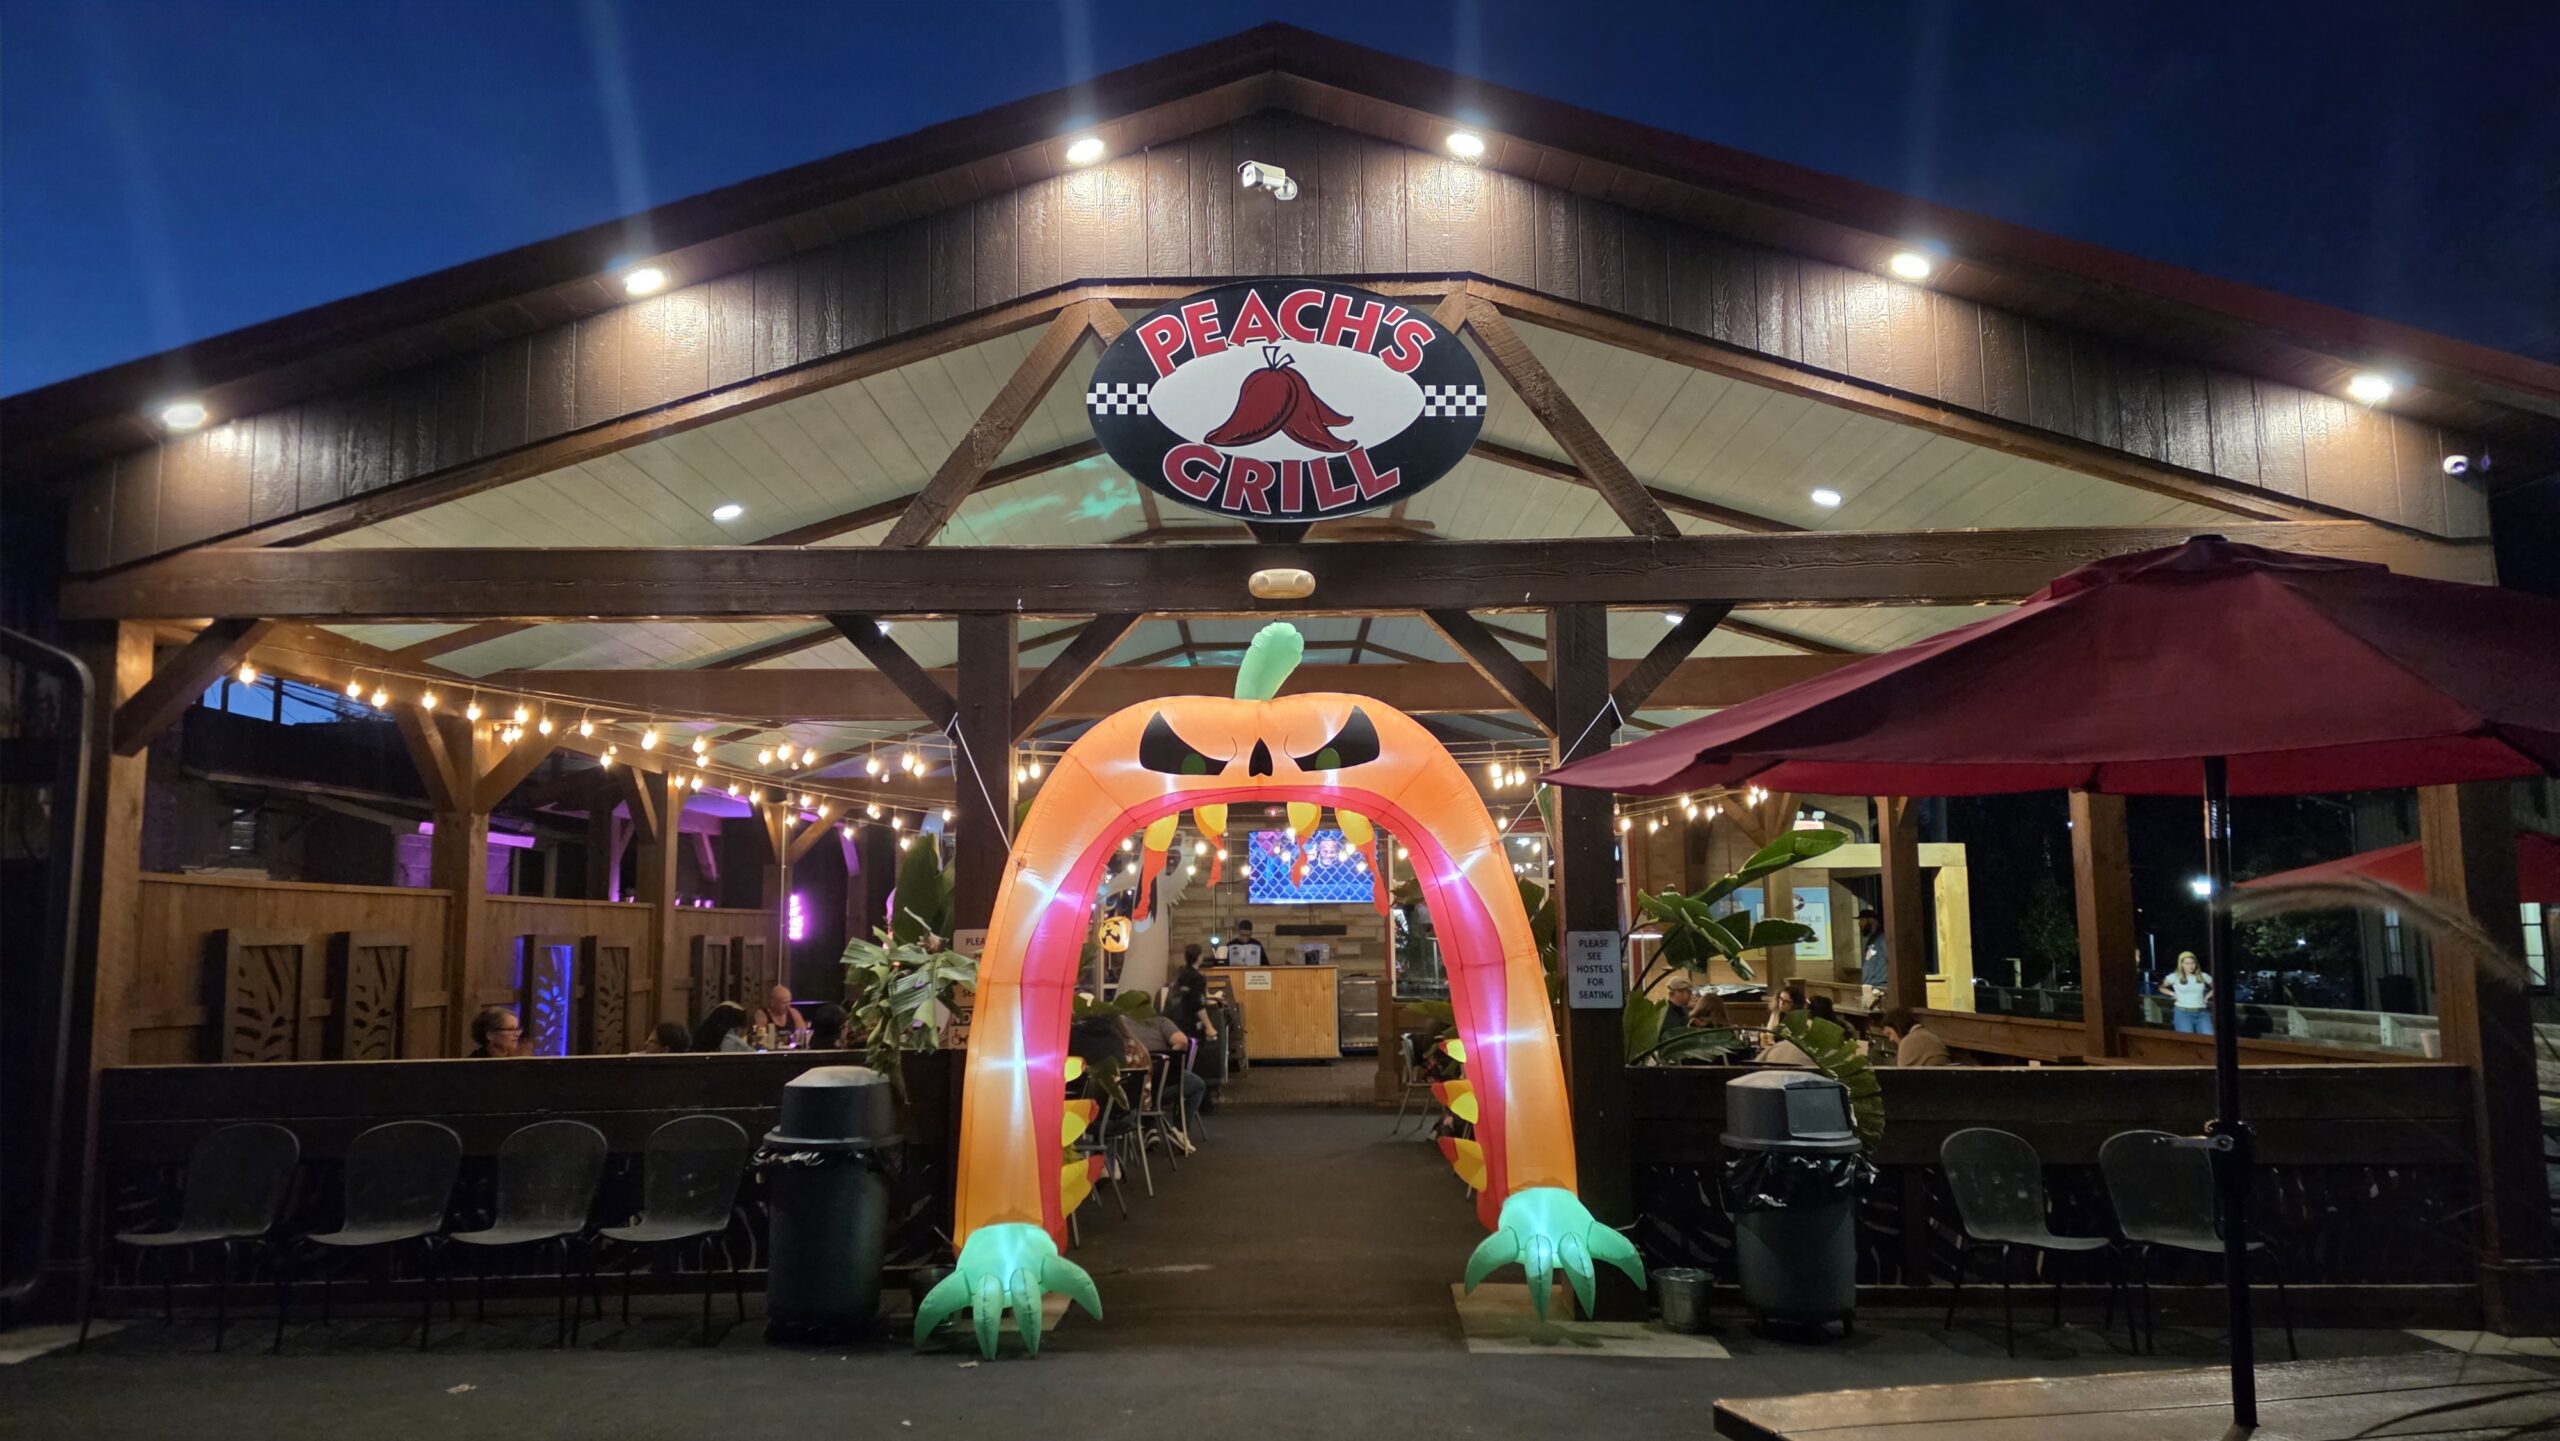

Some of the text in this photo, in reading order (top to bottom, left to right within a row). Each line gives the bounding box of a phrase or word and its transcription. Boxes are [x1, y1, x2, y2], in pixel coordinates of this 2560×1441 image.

[1136, 288, 1436, 378] PEACH'S
[1162, 443, 1400, 514] GRILL
[965, 936, 985, 946] PLEA
[1578, 939, 1609, 948] PLEASE
[1587, 952, 1602, 960] SEE
[1576, 965, 1614, 973] HOSTESS
[1587, 977, 1605, 986] FOR
[1578, 990, 1614, 999] SEATING
